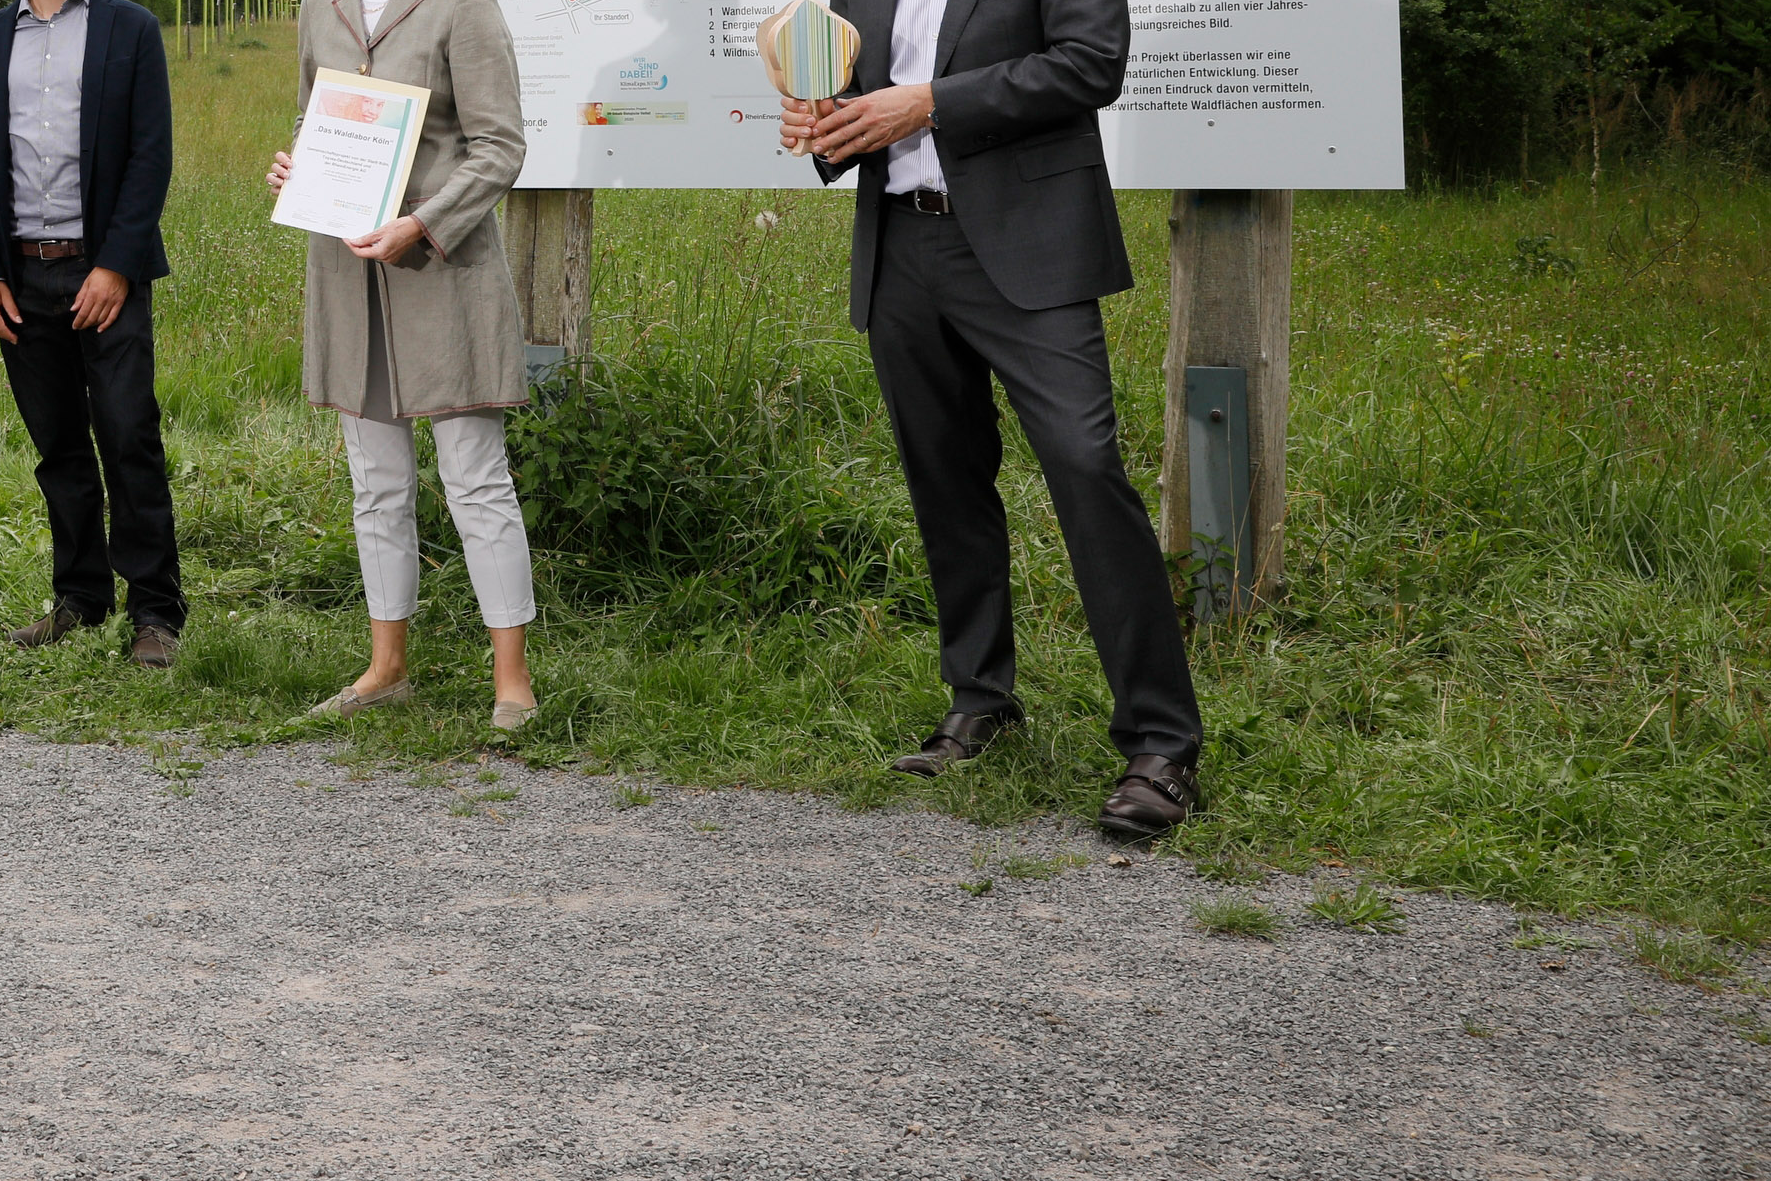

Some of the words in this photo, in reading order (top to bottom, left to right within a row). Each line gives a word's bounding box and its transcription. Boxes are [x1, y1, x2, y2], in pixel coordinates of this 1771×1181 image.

[709, 8, 713, 16] 1
[721, 6, 775, 16] Wandelwald
[709, 22, 714, 30] 2
[709, 35, 715, 44] 3
[722, 34, 756, 43] Klimaw
[709, 49, 715, 57] 4
[1141, 51, 1179, 64] Projekt
[1182, 50, 1242, 62] überlassen
[1245, 49, 1264, 60] wir
[1267, 49, 1291, 60] eine
[620, 70, 653, 79] DABEI!
[1125, 67, 1186, 79] natürlichen
[1189, 66, 1259, 79] Entwicklung.
[1263, 65, 1299, 76] Dieser
[1132, 84, 1162, 95] einen
[1165, 83, 1213, 94] Eindruck
[1215, 83, 1249, 94] davon
[1252, 82, 1313, 93] vermitteln,
[334, 128, 371, 141] Waldlabor
